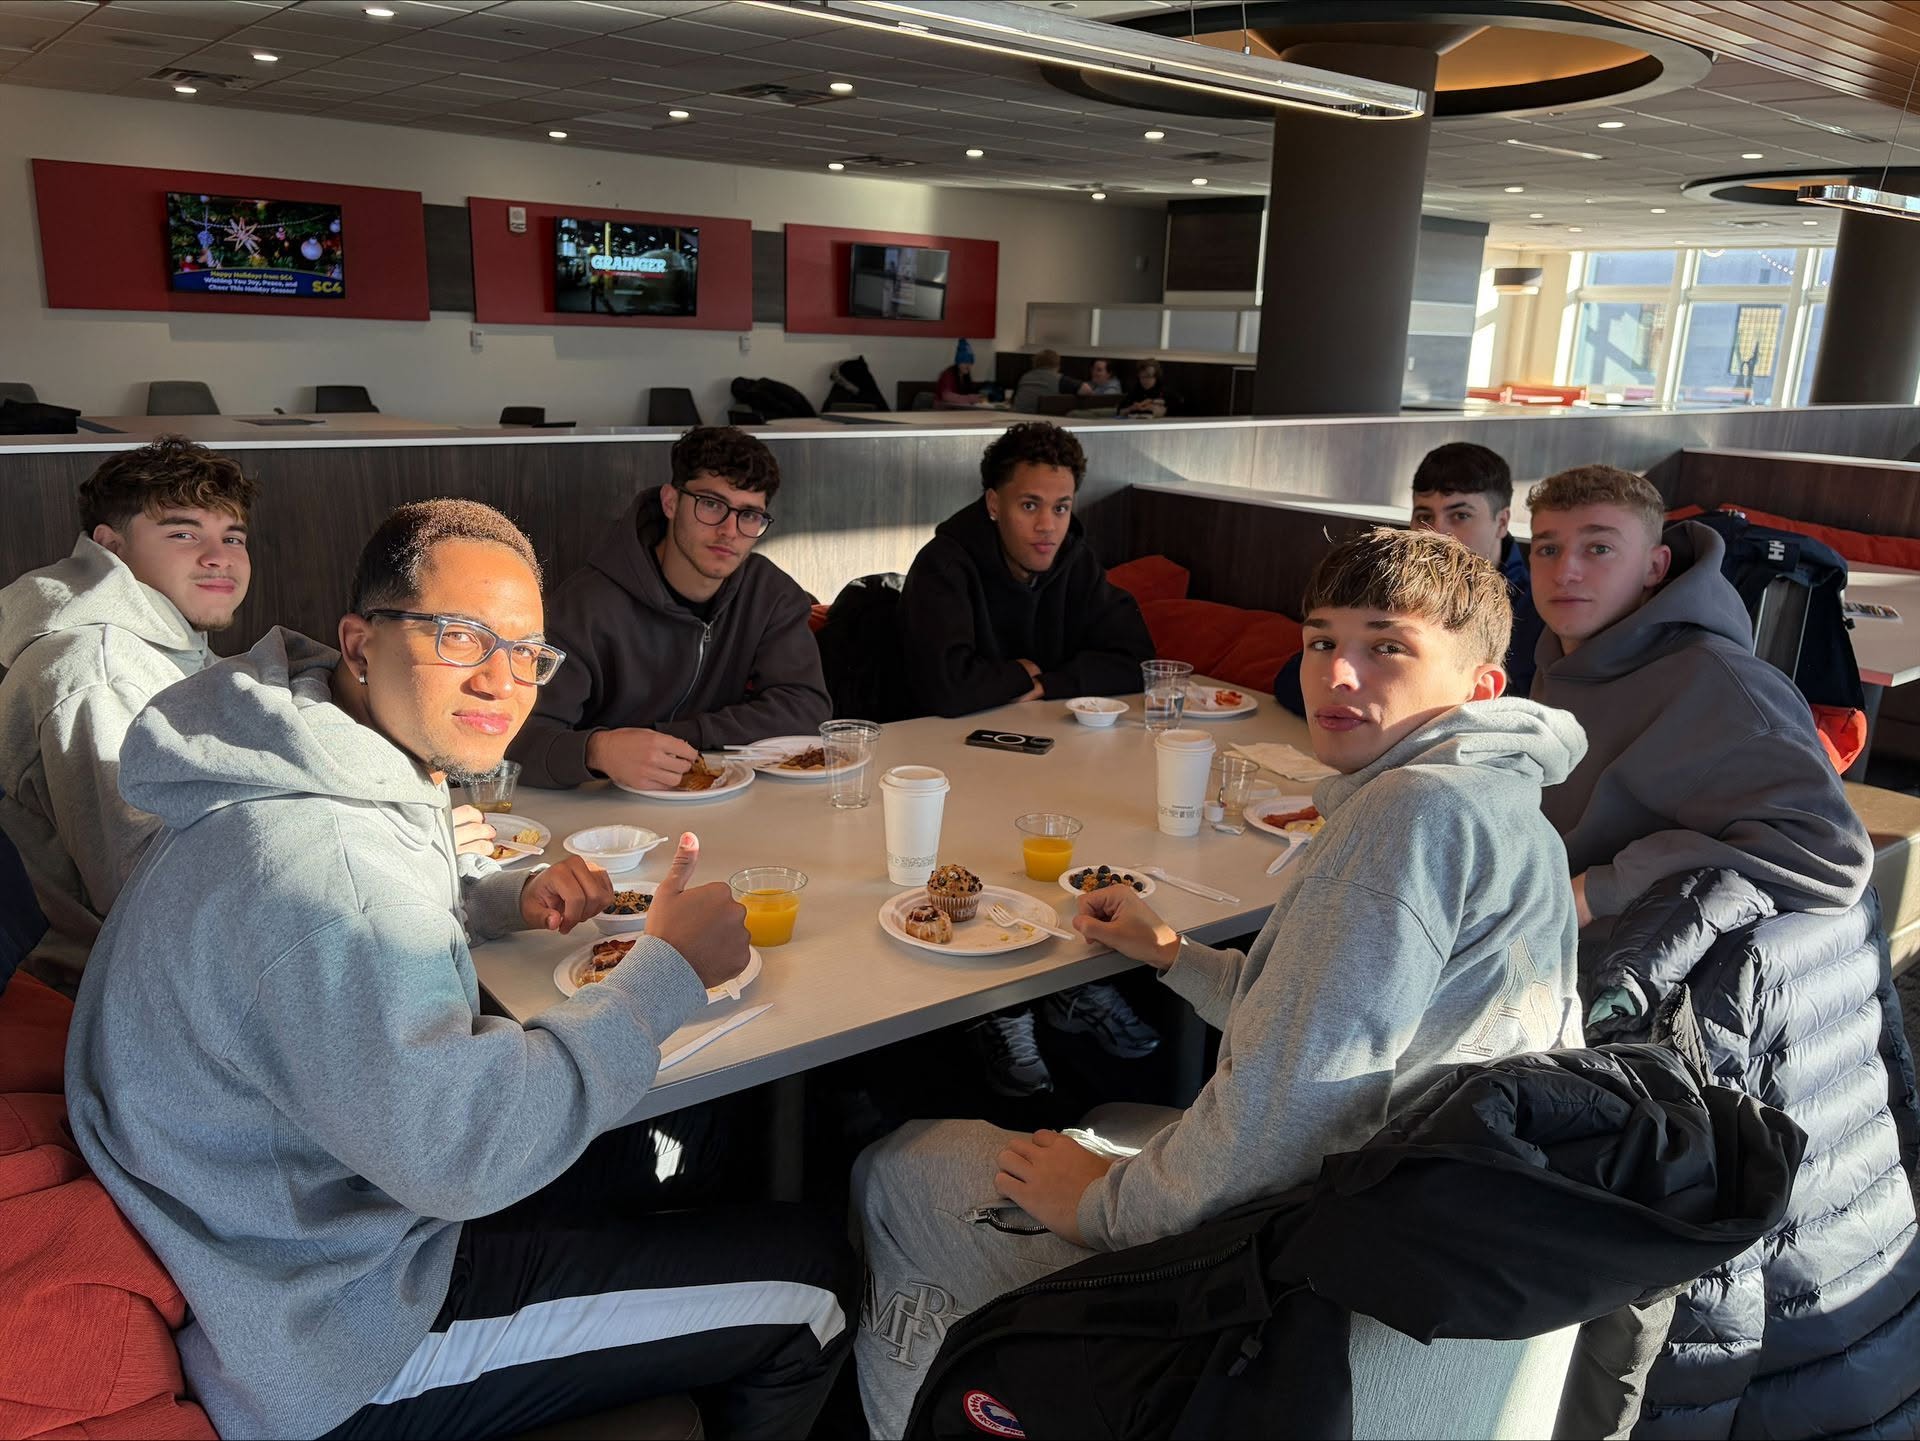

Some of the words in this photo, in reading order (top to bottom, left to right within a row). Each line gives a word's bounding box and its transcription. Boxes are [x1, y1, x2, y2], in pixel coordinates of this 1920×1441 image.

[591, 254, 668, 273] GRAINGER
[234, 271, 262, 280] Holidays
[203, 276, 233, 285] Wishing
[244, 286, 270, 294] Holiday
[312, 280, 342, 293] SC4
